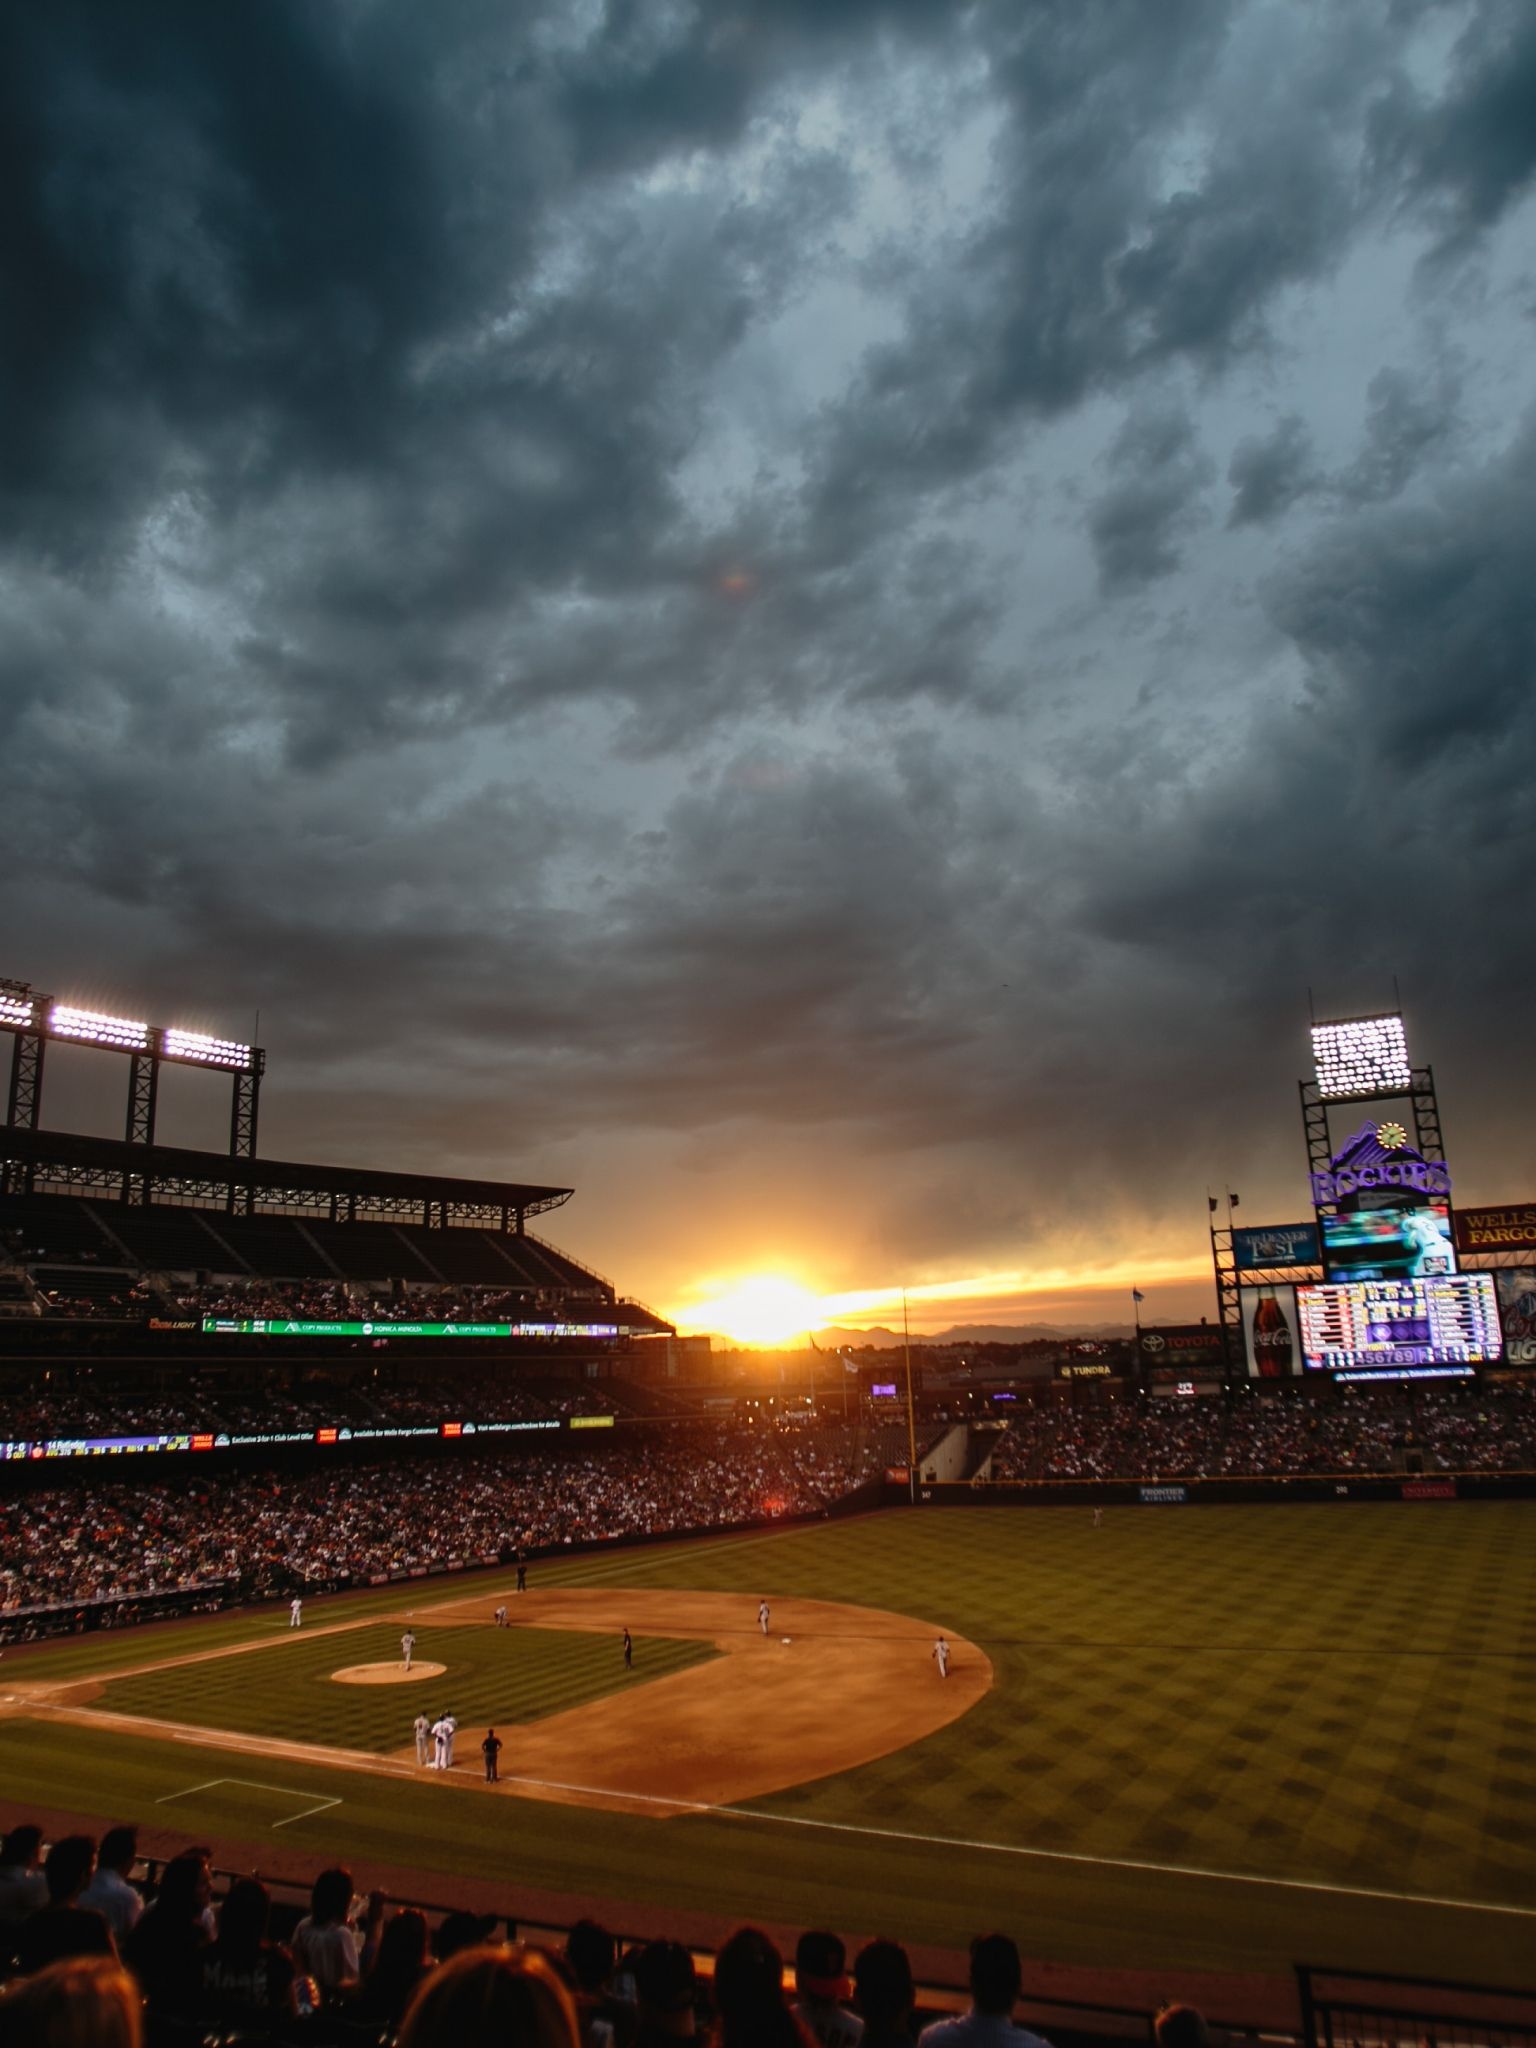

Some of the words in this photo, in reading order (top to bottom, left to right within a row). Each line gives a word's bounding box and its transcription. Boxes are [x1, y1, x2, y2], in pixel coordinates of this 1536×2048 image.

[1308, 1162, 1452, 1205] ROCKIES
[1465, 1211, 1536, 1228] WELLS
[1261, 1231, 1308, 1243] DENVER
[1469, 1227, 1536, 1244] FARGO
[172, 1321, 196, 1329] LIGHT
[1167, 1335, 1221, 1349] TOYOTA
[1073, 1365, 1111, 1377] TUNDRA
[398, 1428, 412, 1437] Fargo
[412, 1427, 438, 1435] Customers
[232, 1436, 256, 1444] Exclusive
[287, 1433, 300, 1441] Level
[12, 1451, 26, 1459] OUT
[1140, 1487, 1185, 1496] FRONTIER
